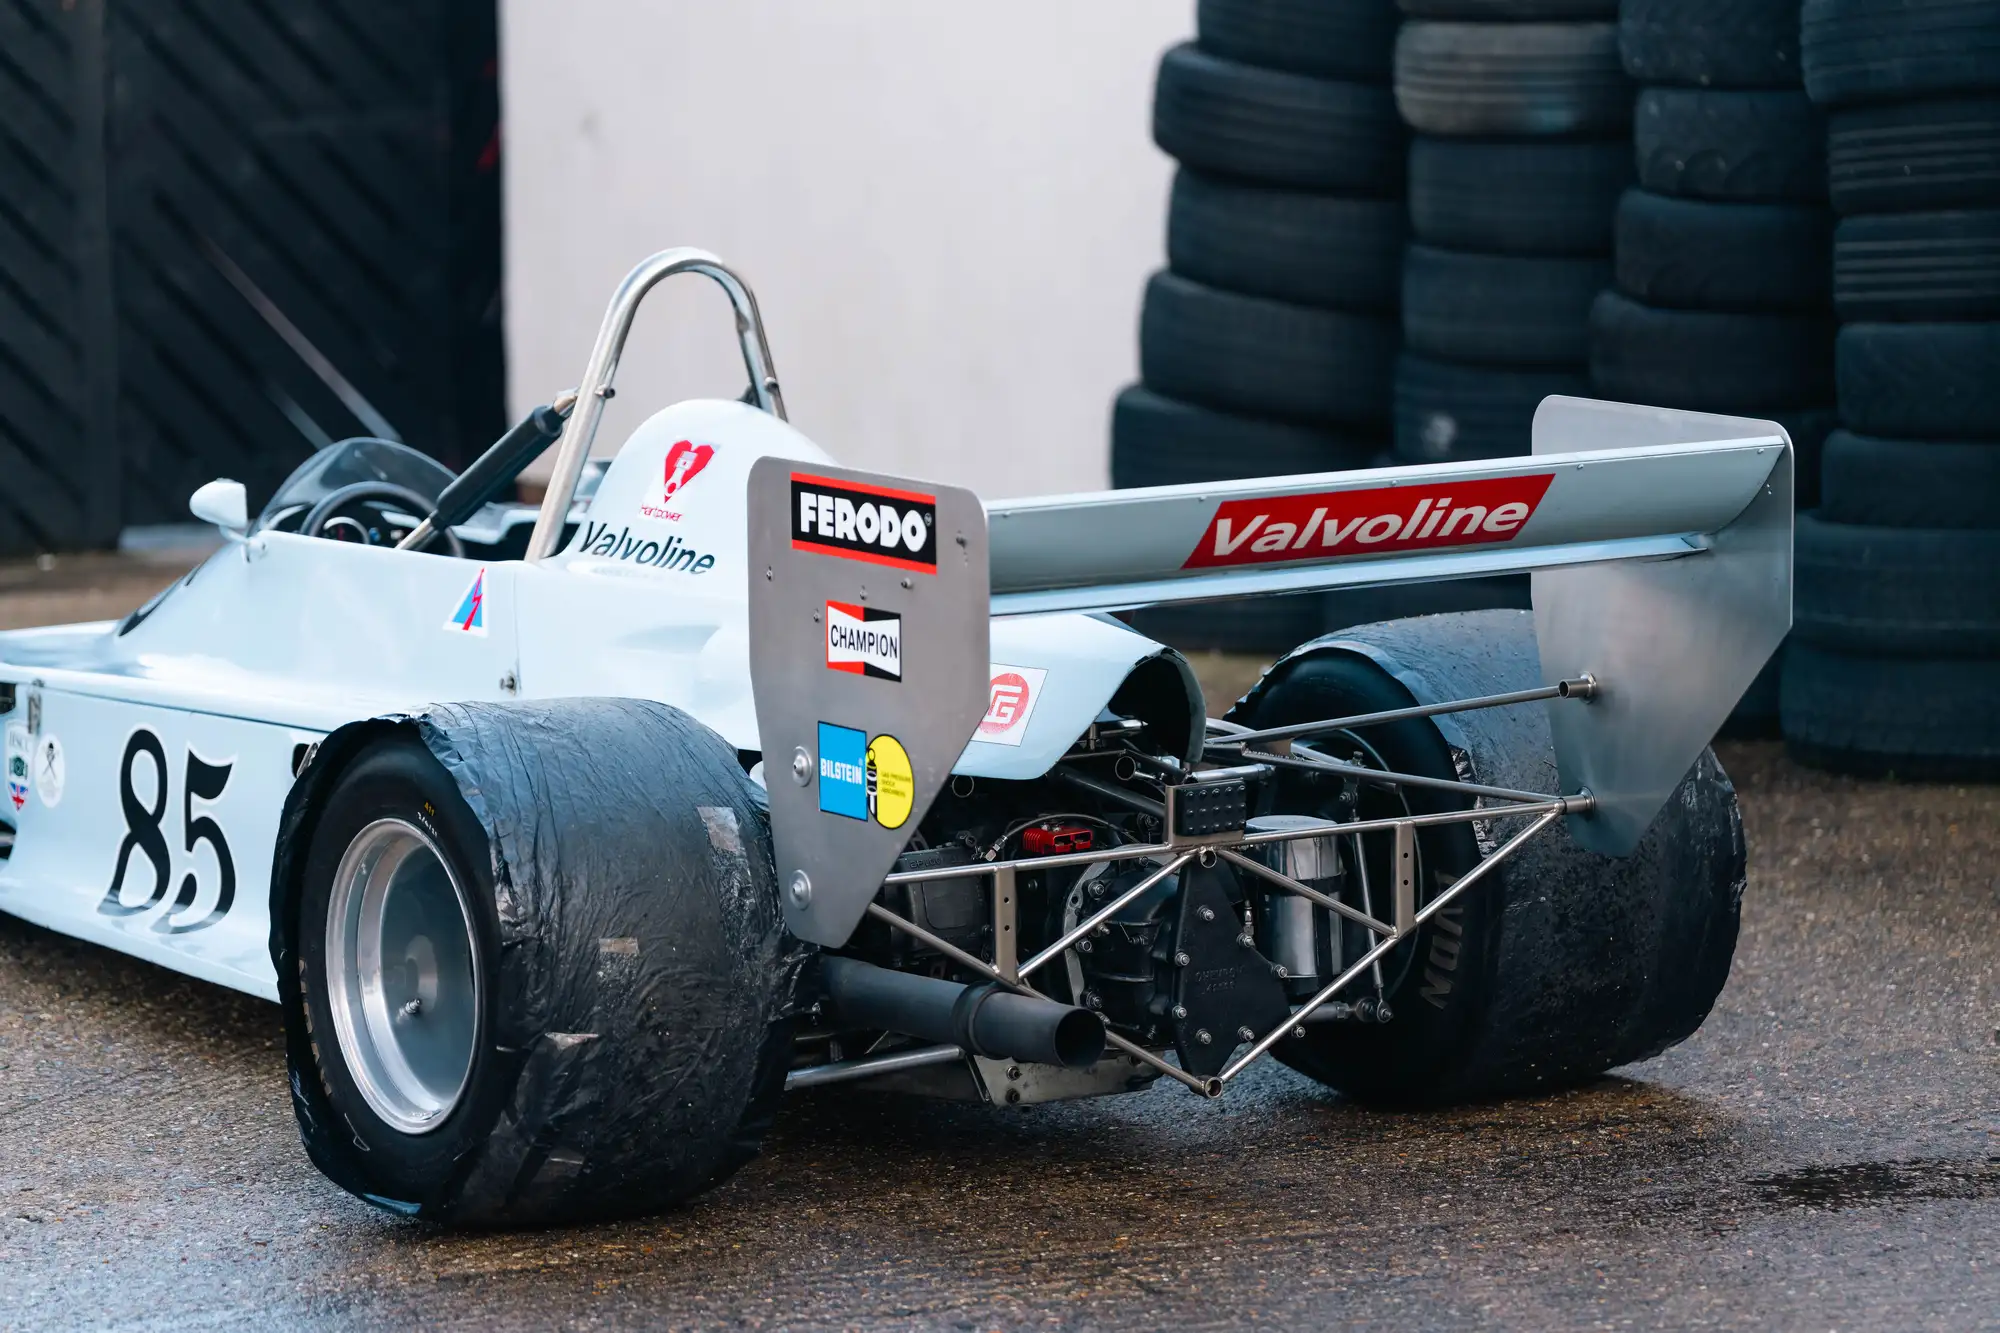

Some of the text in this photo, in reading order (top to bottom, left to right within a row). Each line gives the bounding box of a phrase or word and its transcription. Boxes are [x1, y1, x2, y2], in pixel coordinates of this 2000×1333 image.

[579, 521, 715, 574] Valvoline
[800, 491, 927, 552] FERODO
[1213, 497, 1529, 557] Valvoline
[830, 624, 898, 659] CHAMPION
[820, 757, 863, 785] BILSTEIN
[96, 727, 237, 935] 85
